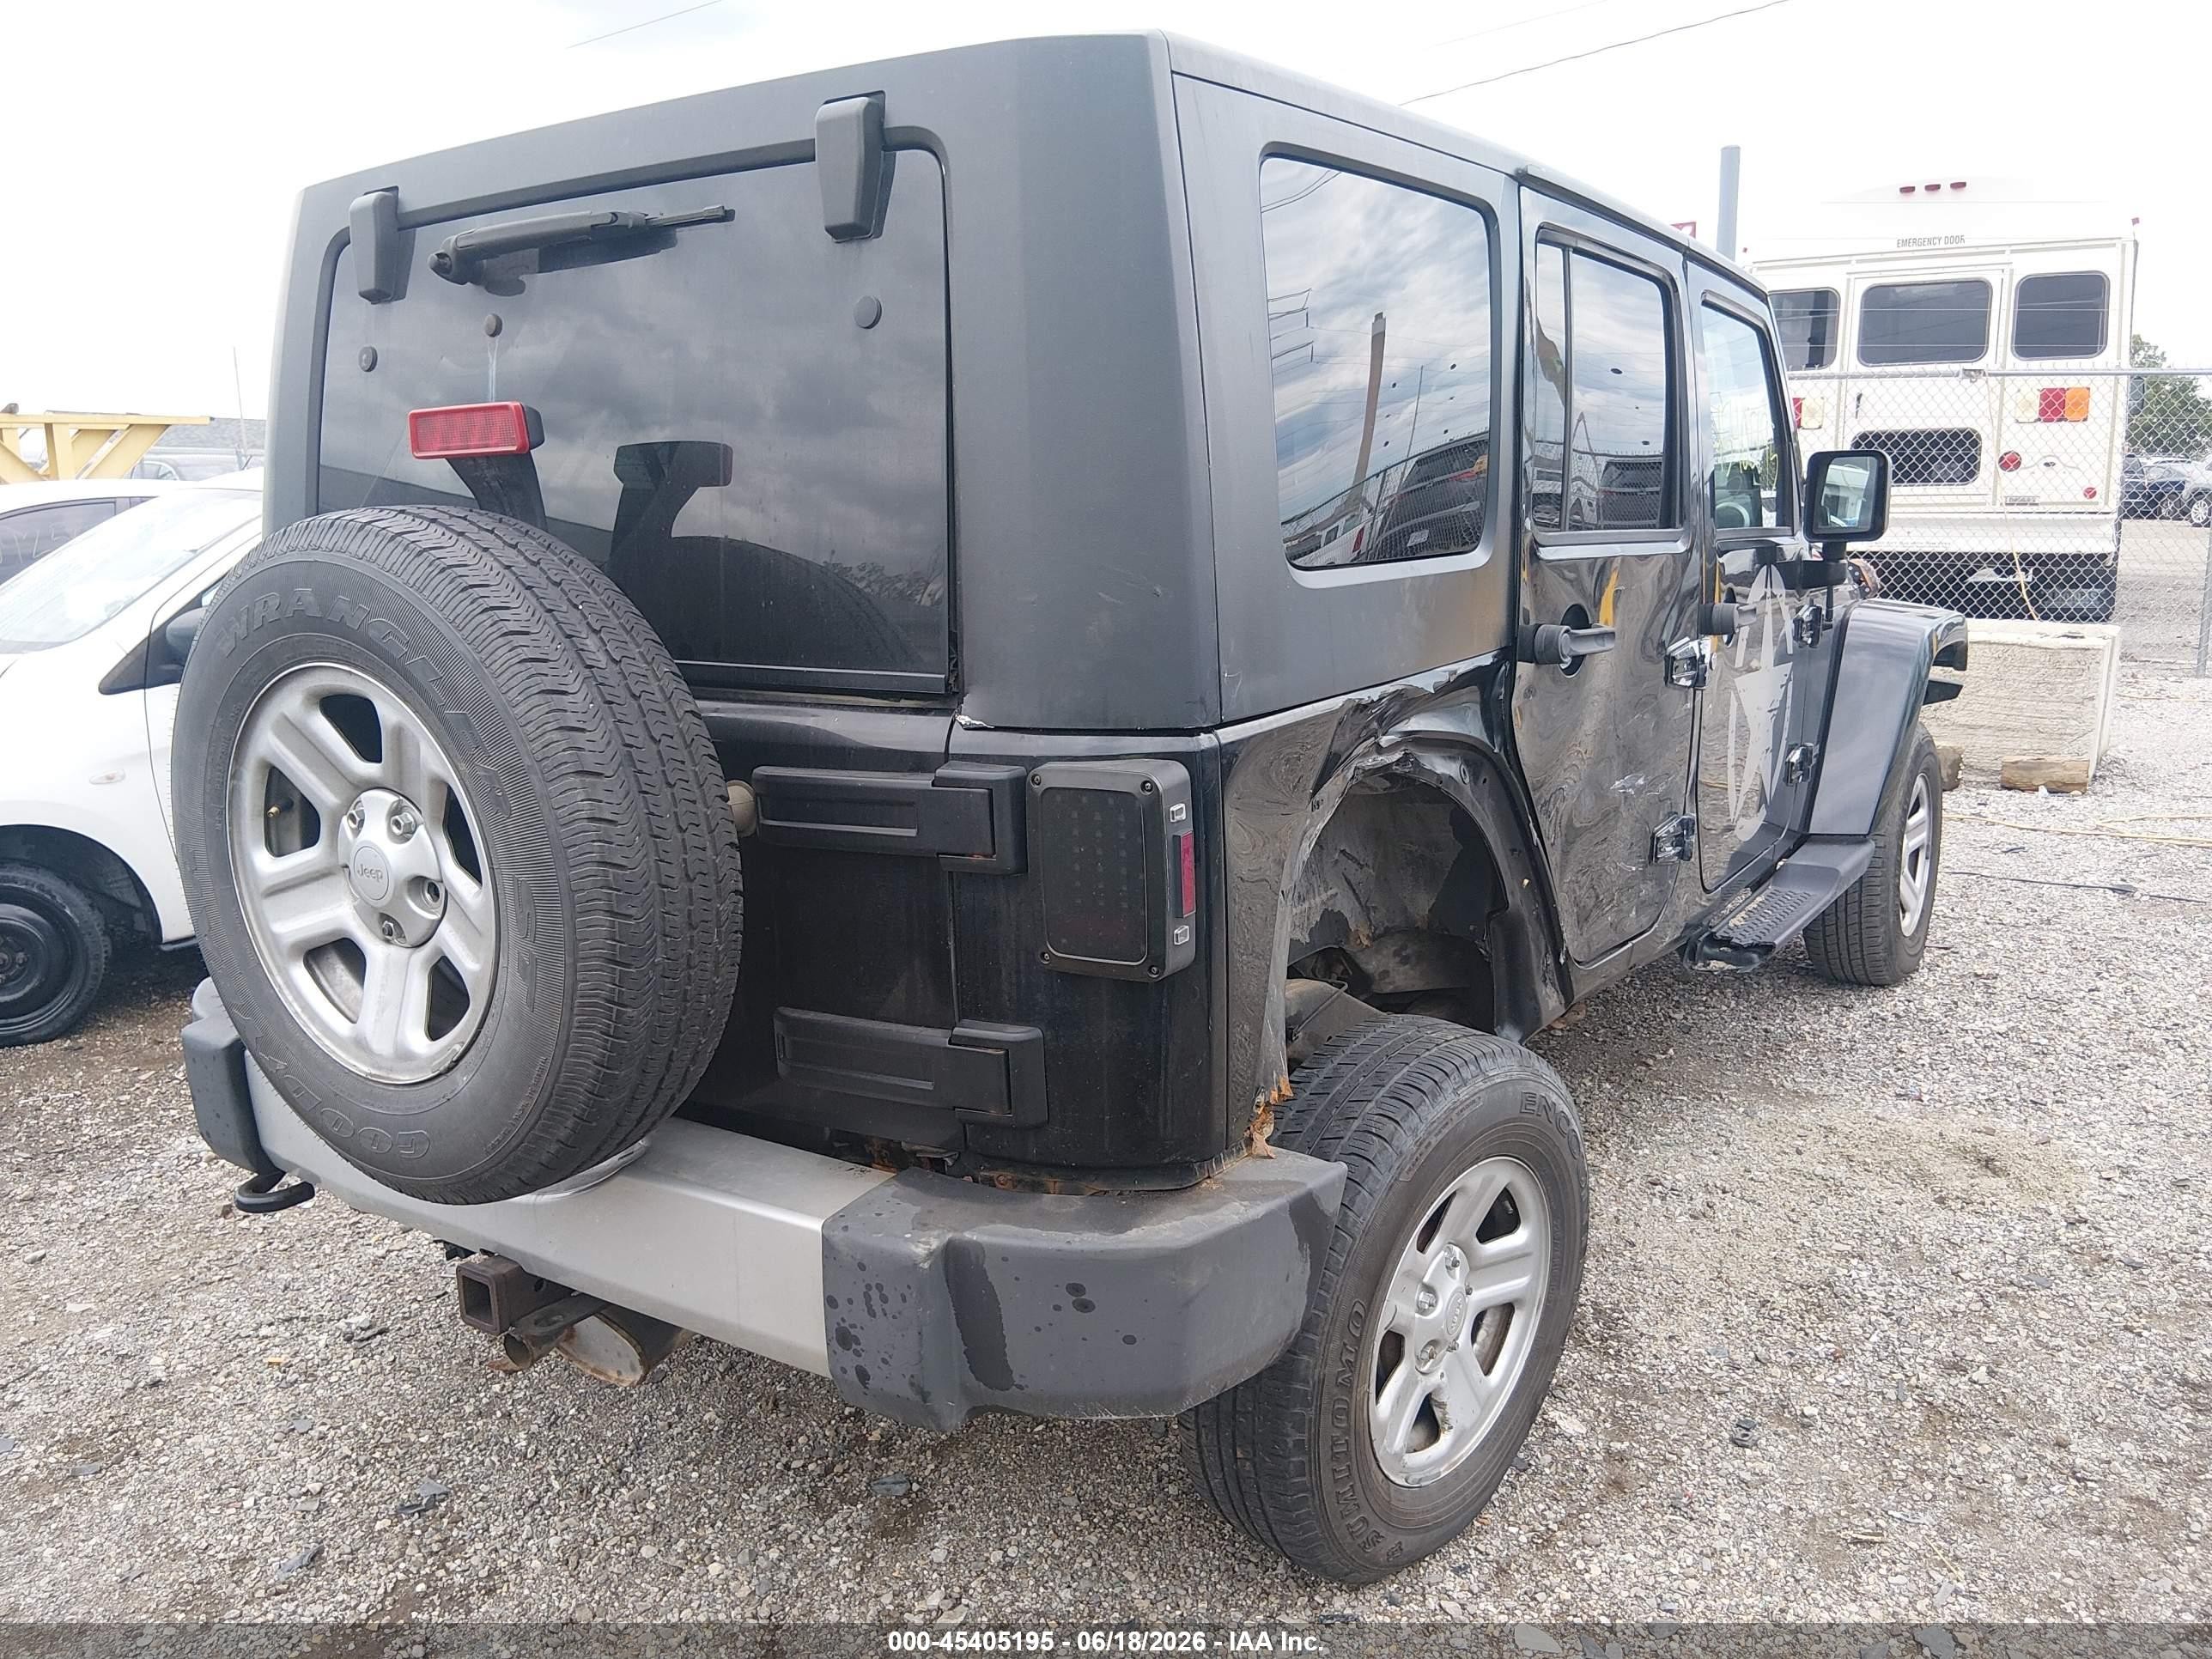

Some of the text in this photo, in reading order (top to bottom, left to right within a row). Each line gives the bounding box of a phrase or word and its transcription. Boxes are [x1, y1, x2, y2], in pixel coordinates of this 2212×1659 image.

[1896, 234, 1966, 248] EMERGENCY DOOR
[216, 586, 513, 820] WRANGLER
[356, 862, 384, 884] Jeep
[1331, 1298, 1385, 1553] SUMITOMO
